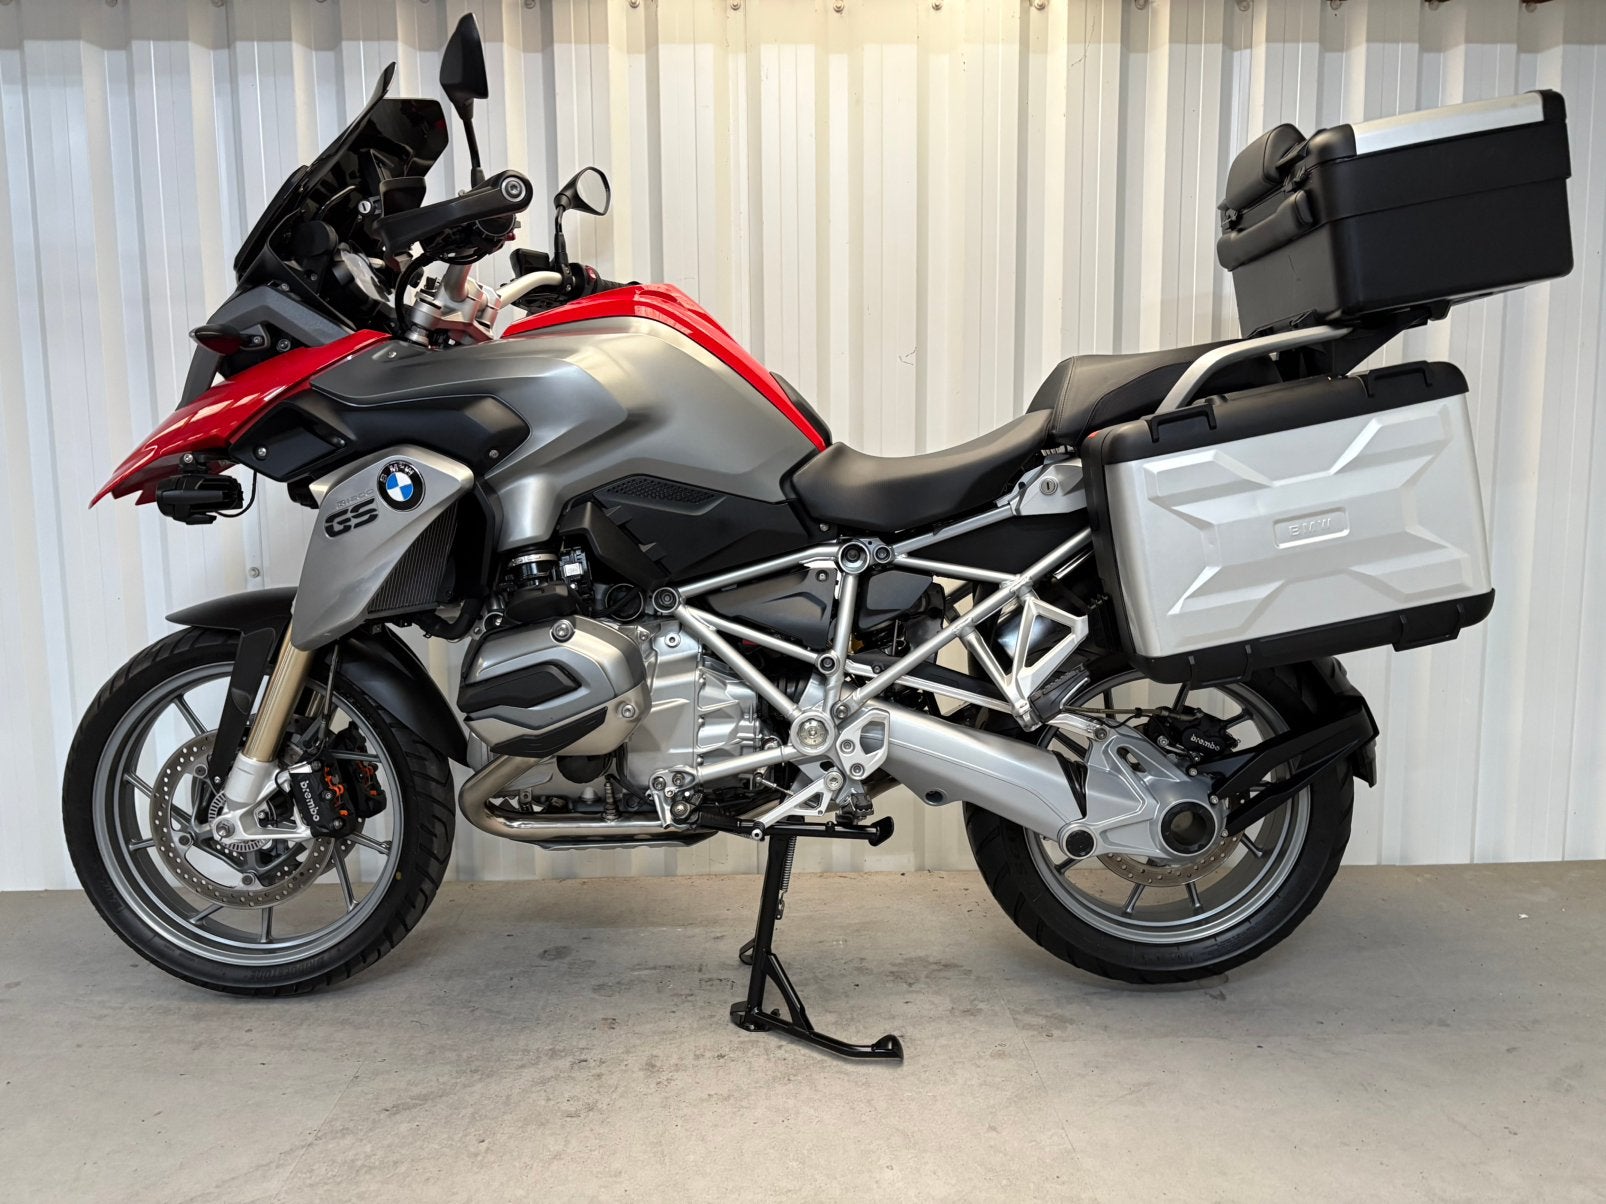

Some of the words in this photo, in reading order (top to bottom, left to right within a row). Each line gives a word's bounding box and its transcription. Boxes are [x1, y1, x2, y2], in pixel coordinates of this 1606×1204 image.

[379, 462, 415, 483] BMW
[324, 497, 379, 538] GS
[1190, 734, 1220, 751] brembo
[300, 780, 320, 821] brembo
